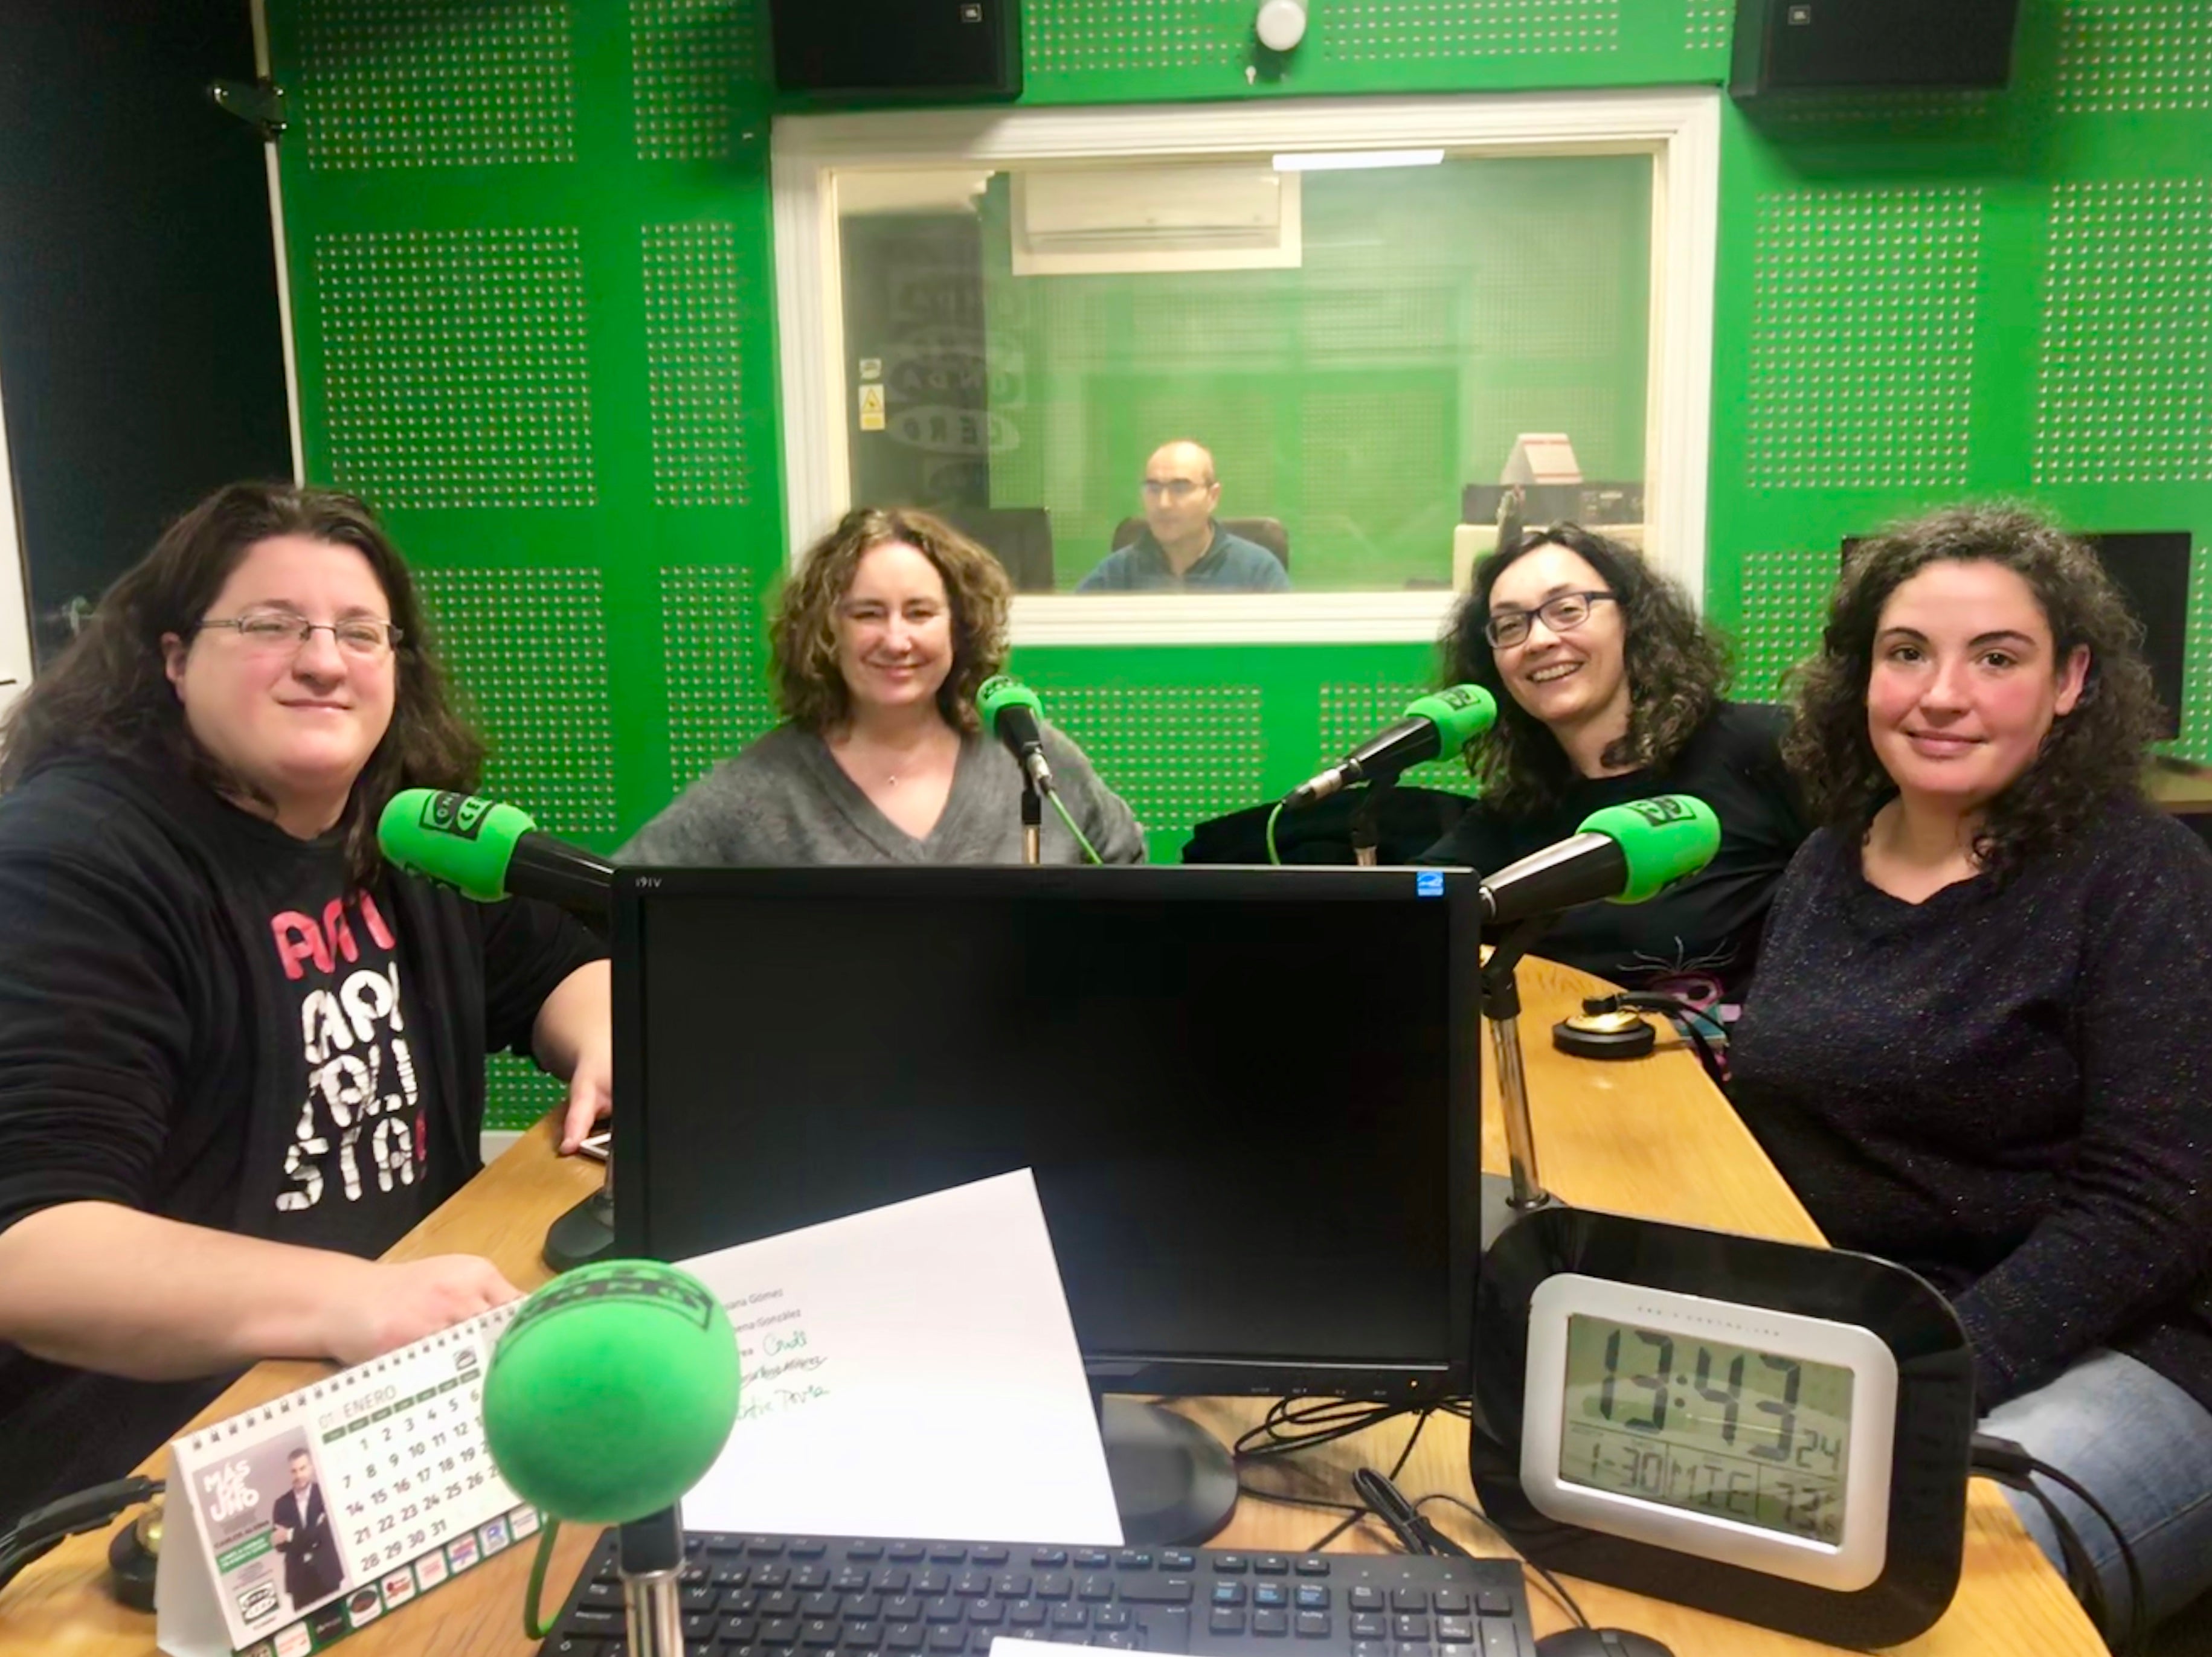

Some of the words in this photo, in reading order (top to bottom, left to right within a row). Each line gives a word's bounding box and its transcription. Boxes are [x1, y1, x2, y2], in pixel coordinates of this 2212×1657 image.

[343, 1385, 397, 1418] ENERO
[361, 1438, 368, 1450] 1
[382, 1427, 391, 1442] 2
[405, 1417, 414, 1432] 3
[427, 1409, 437, 1420] 4
[449, 1398, 458, 1412] 5
[470, 1388, 480, 1402] 6
[1600, 1328, 1803, 1461] 13:43
[203, 1458, 251, 1493] MÁS
[343, 1475, 351, 1489] 7
[365, 1464, 378, 1479] 8
[388, 1453, 399, 1467] 9
[408, 1441, 426, 1458] 10
[431, 1432, 446, 1447] 11
[452, 1421, 469, 1437] 12
[346, 1501, 364, 1516] 14
[370, 1488, 388, 1505] 15
[393, 1478, 411, 1493] 16
[416, 1467, 431, 1482] 17
[438, 1457, 455, 1473] 18
[460, 1446, 476, 1463] 19
[1796, 1428, 1842, 1472] 24
[354, 1526, 371, 1545] 21
[377, 1514, 396, 1534] 22
[400, 1504, 419, 1522] 23
[423, 1494, 440, 1511] 24
[445, 1481, 462, 1500] 25
[466, 1472, 484, 1490] 26
[361, 1552, 381, 1572] 28
[384, 1540, 402, 1560] 29
[407, 1529, 426, 1548] 30
[431, 1519, 447, 1536] 31
